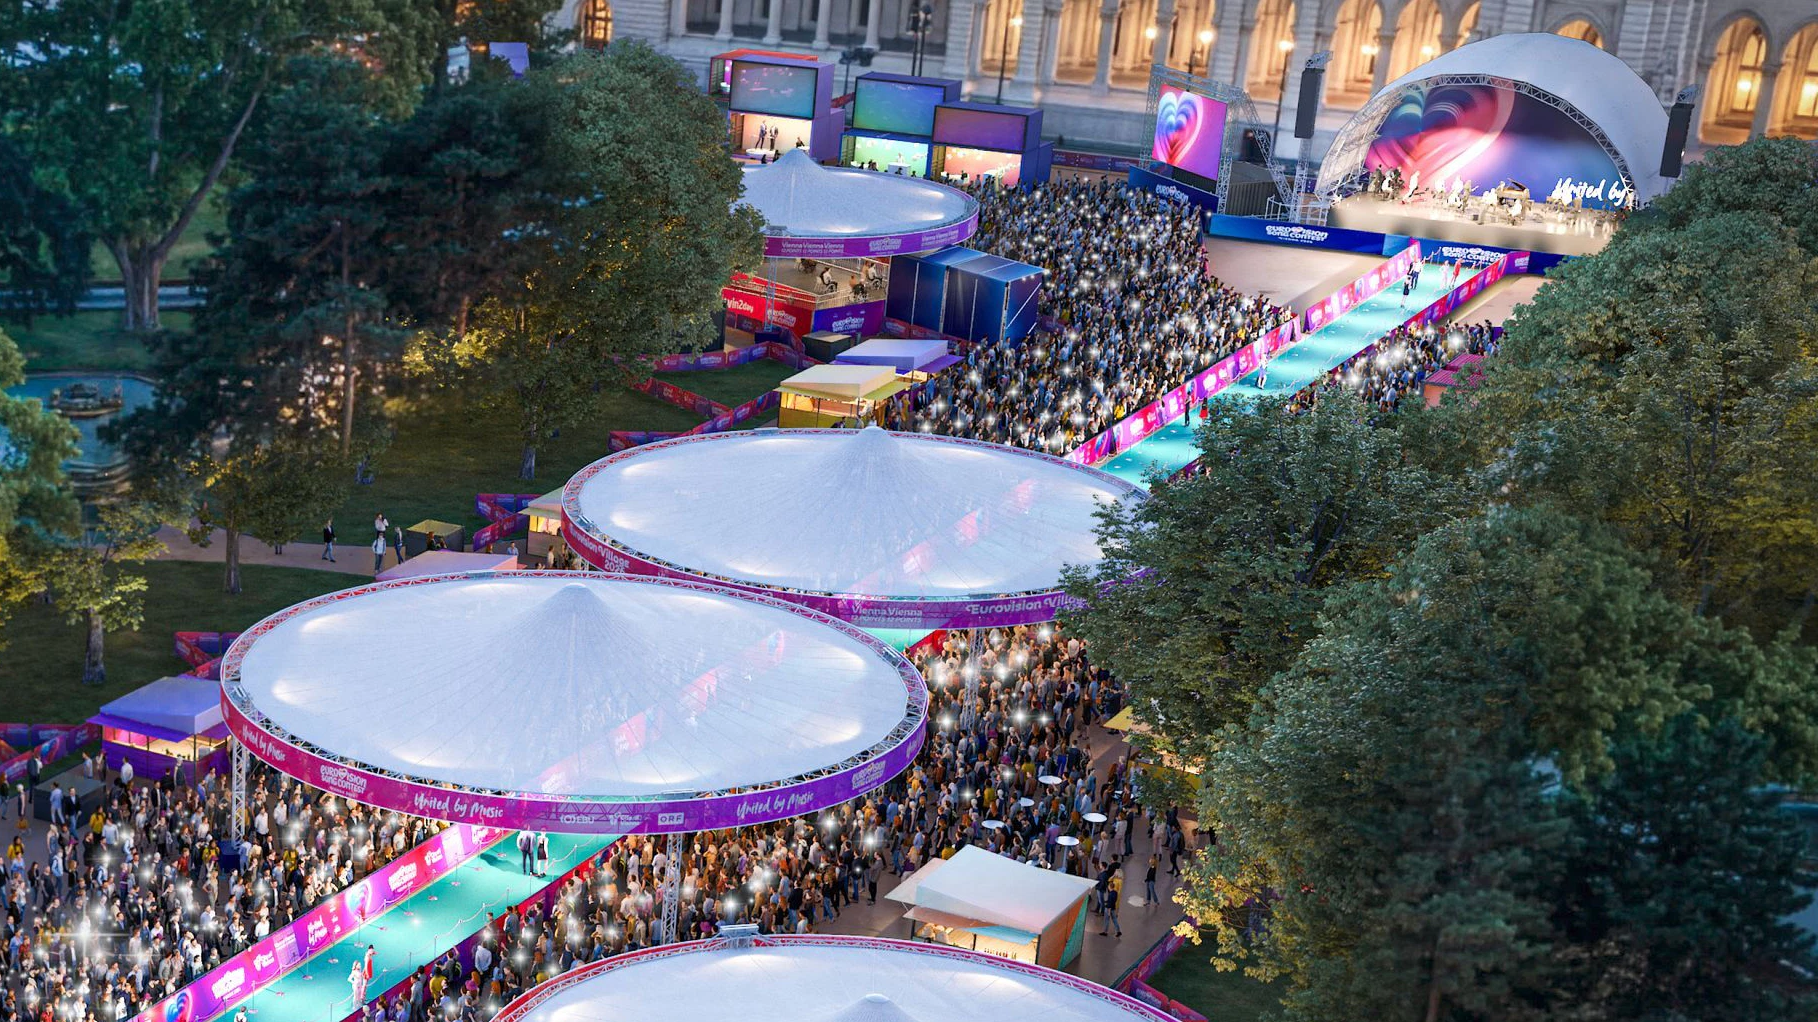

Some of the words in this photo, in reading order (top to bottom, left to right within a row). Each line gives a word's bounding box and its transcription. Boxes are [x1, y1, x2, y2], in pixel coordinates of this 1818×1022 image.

[1551, 177, 1606, 205] United
[965, 601, 1042, 616] Eurovision
[413, 792, 450, 813] United
[453, 798, 467, 817] by
[469, 803, 504, 819] Music
[737, 797, 770, 818] United
[773, 794, 786, 813] by
[787, 791, 814, 810] Music
[658, 814, 684, 823] ORF
